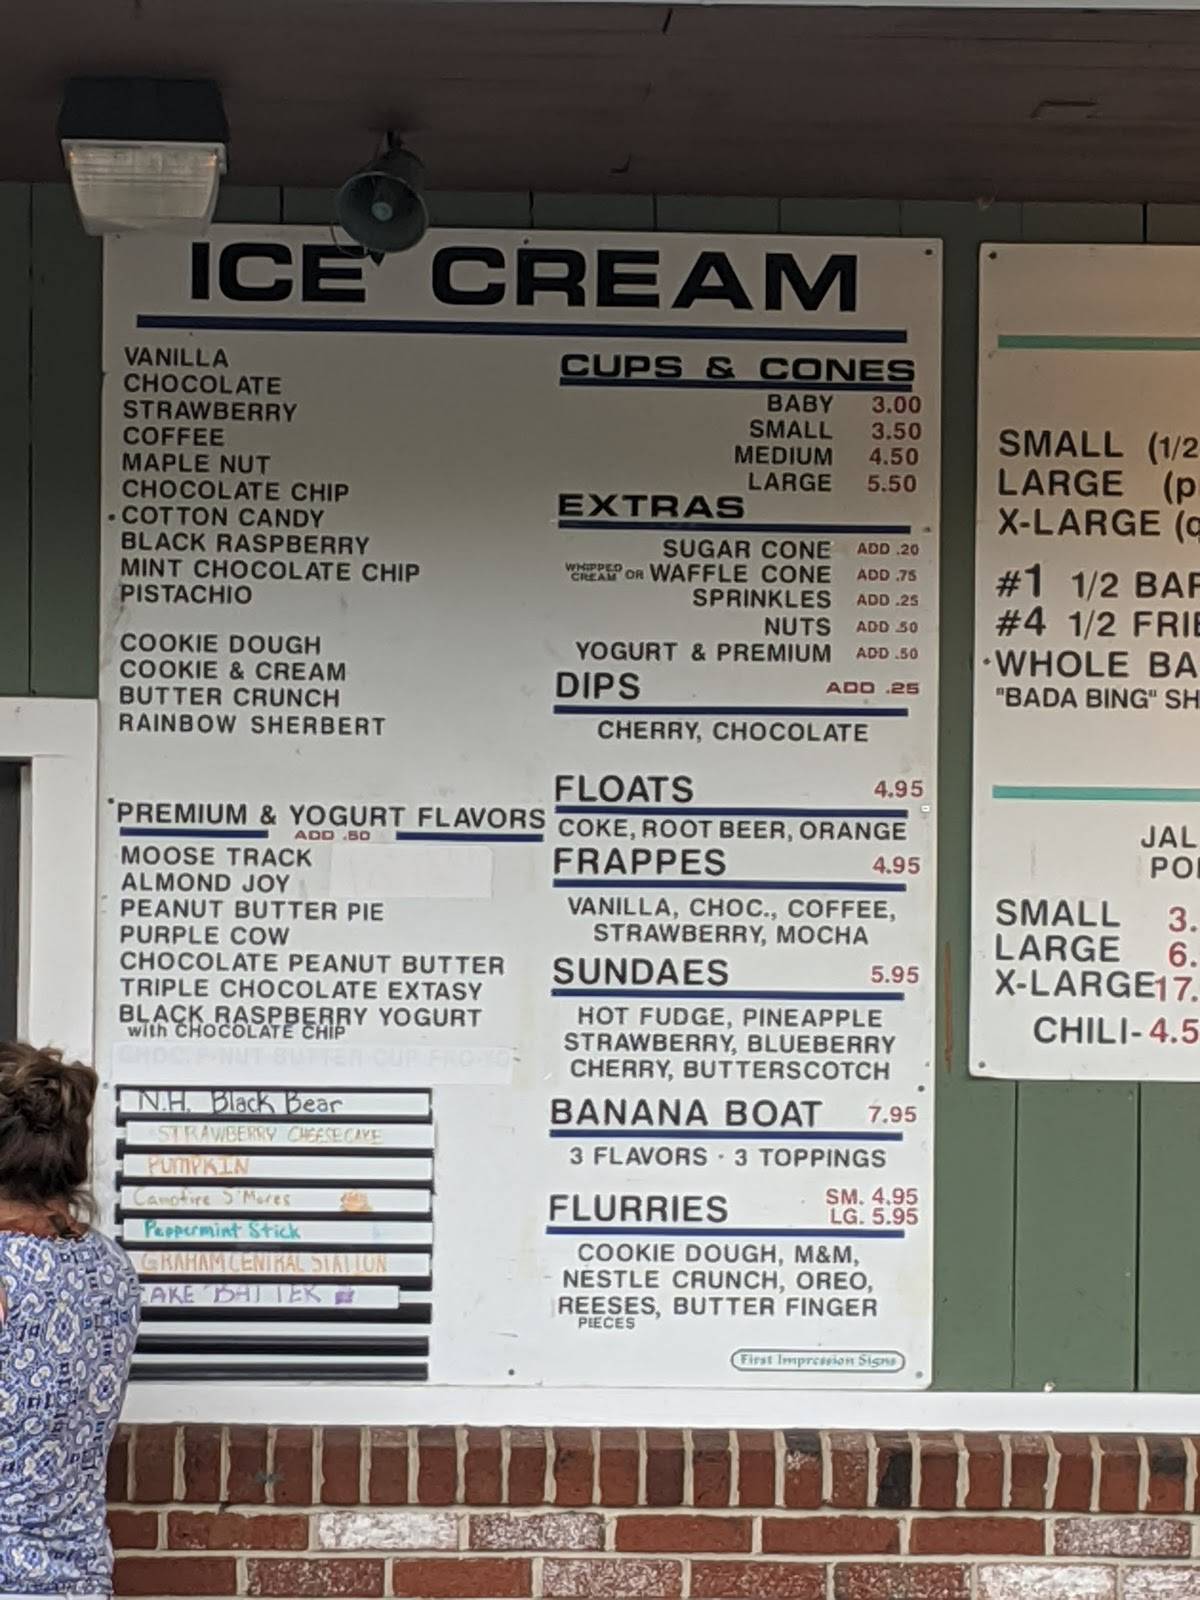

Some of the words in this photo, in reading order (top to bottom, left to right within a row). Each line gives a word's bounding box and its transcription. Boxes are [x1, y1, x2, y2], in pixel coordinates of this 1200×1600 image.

[191, 241, 366, 302] ICE
[431, 247, 858, 312] CREAM
[125, 347, 228, 368] VANILLA
[560, 354, 682, 379] CUPS
[759, 359, 915, 382] CONES
[124, 373, 281, 395] CHOCOLATE
[124, 400, 297, 422] STRAWBERRY
[768, 394, 833, 413] BABY
[872, 396, 921, 414] 3.00
[124, 427, 224, 446] COFFEE
[750, 419, 832, 439] SMALL
[872, 422, 921, 440] 3.50
[1000, 429, 1123, 457] SMALL
[123, 453, 209, 473] MAPLE
[221, 455, 270, 475] NUT
[735, 446, 832, 465] MEDIUM
[869, 447, 918, 465] 4.50
[123, 479, 280, 501] CHOCOLATE
[291, 483, 348, 502] CHIP
[749, 472, 831, 492] LARGE
[868, 474, 916, 492] 5.50
[999, 468, 1123, 497] LARGE
[122, 505, 227, 526] COTTON
[239, 508, 324, 528] CANDY
[559, 494, 744, 518] EXTRAS
[999, 508, 1160, 536] X-LARGE
[122, 532, 205, 552] BLACK
[217, 533, 369, 555] RASPBERRY
[664, 539, 750, 558] SUGAR
[762, 540, 830, 560] CONE
[857, 542, 890, 555] ADD
[896, 543, 919, 556] .20
[121, 558, 182, 577] MINT
[194, 560, 350, 581] CHOCOLATE
[362, 563, 419, 582] CHIP
[565, 562, 622, 574] WHIPPED
[571, 572, 617, 582] CREAM
[650, 564, 747, 583] WAFFLE
[762, 565, 830, 583] CONE
[857, 569, 890, 581] ADD
[896, 569, 917, 582] .75
[996, 563, 1041, 599] #1
[1072, 571, 1118, 600] 1/2
[121, 584, 252, 604] PISTACHIO
[693, 589, 831, 609] SPRINKLES
[857, 594, 889, 606] ADD
[896, 594, 918, 606] .25
[765, 617, 830, 636] NUTS
[856, 621, 889, 633] ADD
[895, 621, 918, 633] .50
[996, 606, 1046, 636] #4
[1069, 610, 1116, 640] 1/2
[121, 633, 218, 653] COOKIE
[230, 635, 320, 655] DOUGH
[576, 642, 677, 661] YOGURT
[718, 643, 831, 662] PREMIUM
[856, 647, 889, 659] ADD
[895, 648, 918, 659] .50
[120, 659, 217, 679] COOKIE
[256, 661, 345, 681] CREAM
[995, 650, 1129, 678] WHOLE
[120, 686, 221, 705] BUTTER
[234, 688, 339, 707] CRUNCH
[557, 672, 640, 700] DIPS
[826, 682, 875, 694] ADD
[886, 682, 919, 694] .25
[996, 687, 1078, 708] "BADA
[1085, 689, 1156, 709] BING"
[120, 713, 236, 733] RAINBOW
[252, 716, 385, 735] SHERBERT
[598, 720, 701, 742] CHERRY,
[713, 722, 868, 742] CHOCOLATE
[556, 775, 693, 803] FLOATS
[875, 780, 923, 798] 4.95
[118, 803, 246, 824] PREMIUM
[290, 805, 405, 827] YOGURT
[419, 807, 545, 829] FLAVORS
[559, 819, 635, 840] COKE,
[642, 819, 712, 838] ROOT
[720, 821, 792, 842] BEER,
[800, 821, 906, 840] ORANGE
[122, 846, 214, 865] MOOSE
[227, 848, 311, 867] TRACK
[554, 848, 725, 876] FRAPPES
[873, 856, 920, 874] 4.95
[122, 872, 230, 892] ALMOND
[242, 874, 289, 893] JOY
[121, 899, 223, 918] PEANUT
[235, 901, 337, 920] BUTTER
[348, 903, 383, 921] PIE
[568, 897, 678, 919] VANILLA,
[788, 899, 895, 921] COFFEE,
[996, 899, 1121, 928] SMALL
[121, 925, 219, 945] PURPLE
[231, 927, 289, 945] COW
[594, 924, 766, 946] STRAWBERRY,
[777, 925, 868, 944] MOCHA
[996, 934, 1120, 962] LARGE
[120, 951, 278, 972] CHOCOLATE
[289, 954, 391, 973] PEANUT
[403, 956, 503, 975] BUTTER
[554, 958, 728, 986] SUNDAES
[872, 966, 918, 983] 5.95
[120, 978, 208, 997] TRIPLE
[221, 979, 377, 999] CHOCOLATE
[389, 981, 482, 1000] EXTASY
[996, 969, 1155, 998] X-LARGE
[119, 1004, 204, 1024] BLACK
[214, 1006, 368, 1026] RASPBERRY
[379, 1008, 482, 1027] YOGURT
[579, 1007, 629, 1025] HOT
[640, 1007, 732, 1029] FUDGE,
[744, 1008, 882, 1027] PINEAPPLE
[128, 1024, 167, 1038] with
[176, 1024, 294, 1039] CHOCOLATE
[302, 1025, 345, 1040] CHIP
[1033, 1016, 1142, 1044] CHILI-
[565, 1033, 737, 1055] STRAWBERRY,
[748, 1035, 895, 1054] BLUEBERRY
[571, 1059, 673, 1081] CHERRY,
[684, 1060, 889, 1080] BUTTERSCOTCH
[139, 1091, 191, 1112] N.H.
[212, 1092, 275, 1114] Black
[286, 1092, 343, 1115] Bear
[551, 1099, 708, 1126] BANANA
[726, 1100, 822, 1127] BOAT
[869, 1106, 916, 1123] 7.95
[159, 1125, 274, 1143] STRAWBERRY
[149, 1158, 249, 1174] PUMPKIN
[594, 1147, 707, 1166] FLAVORS
[759, 1148, 886, 1168] TOPPINGS
[826, 1188, 864, 1205] SM.
[872, 1188, 919, 1205] 4.95
[550, 1195, 727, 1223] FLURRIES
[830, 1209, 864, 1225] LG.
[872, 1209, 919, 1225] 5.95
[144, 1220, 241, 1238] Peppermint
[249, 1222, 300, 1239] Stick
[578, 1244, 674, 1262] COOKIE
[686, 1244, 783, 1266] DOUGH,
[564, 1270, 659, 1288] NESTLE
[673, 1270, 784, 1293] CRUNCH,
[797, 1271, 872, 1293] OREO,
[558, 1297, 660, 1318] REESES,
[674, 1297, 774, 1315] BUTTER
[786, 1298, 877, 1316] FINGER
[578, 1317, 635, 1329] PIECES
[740, 1354, 773, 1366] First
[777, 1354, 855, 1368] Impression
[859, 1354, 897, 1369] Signs
